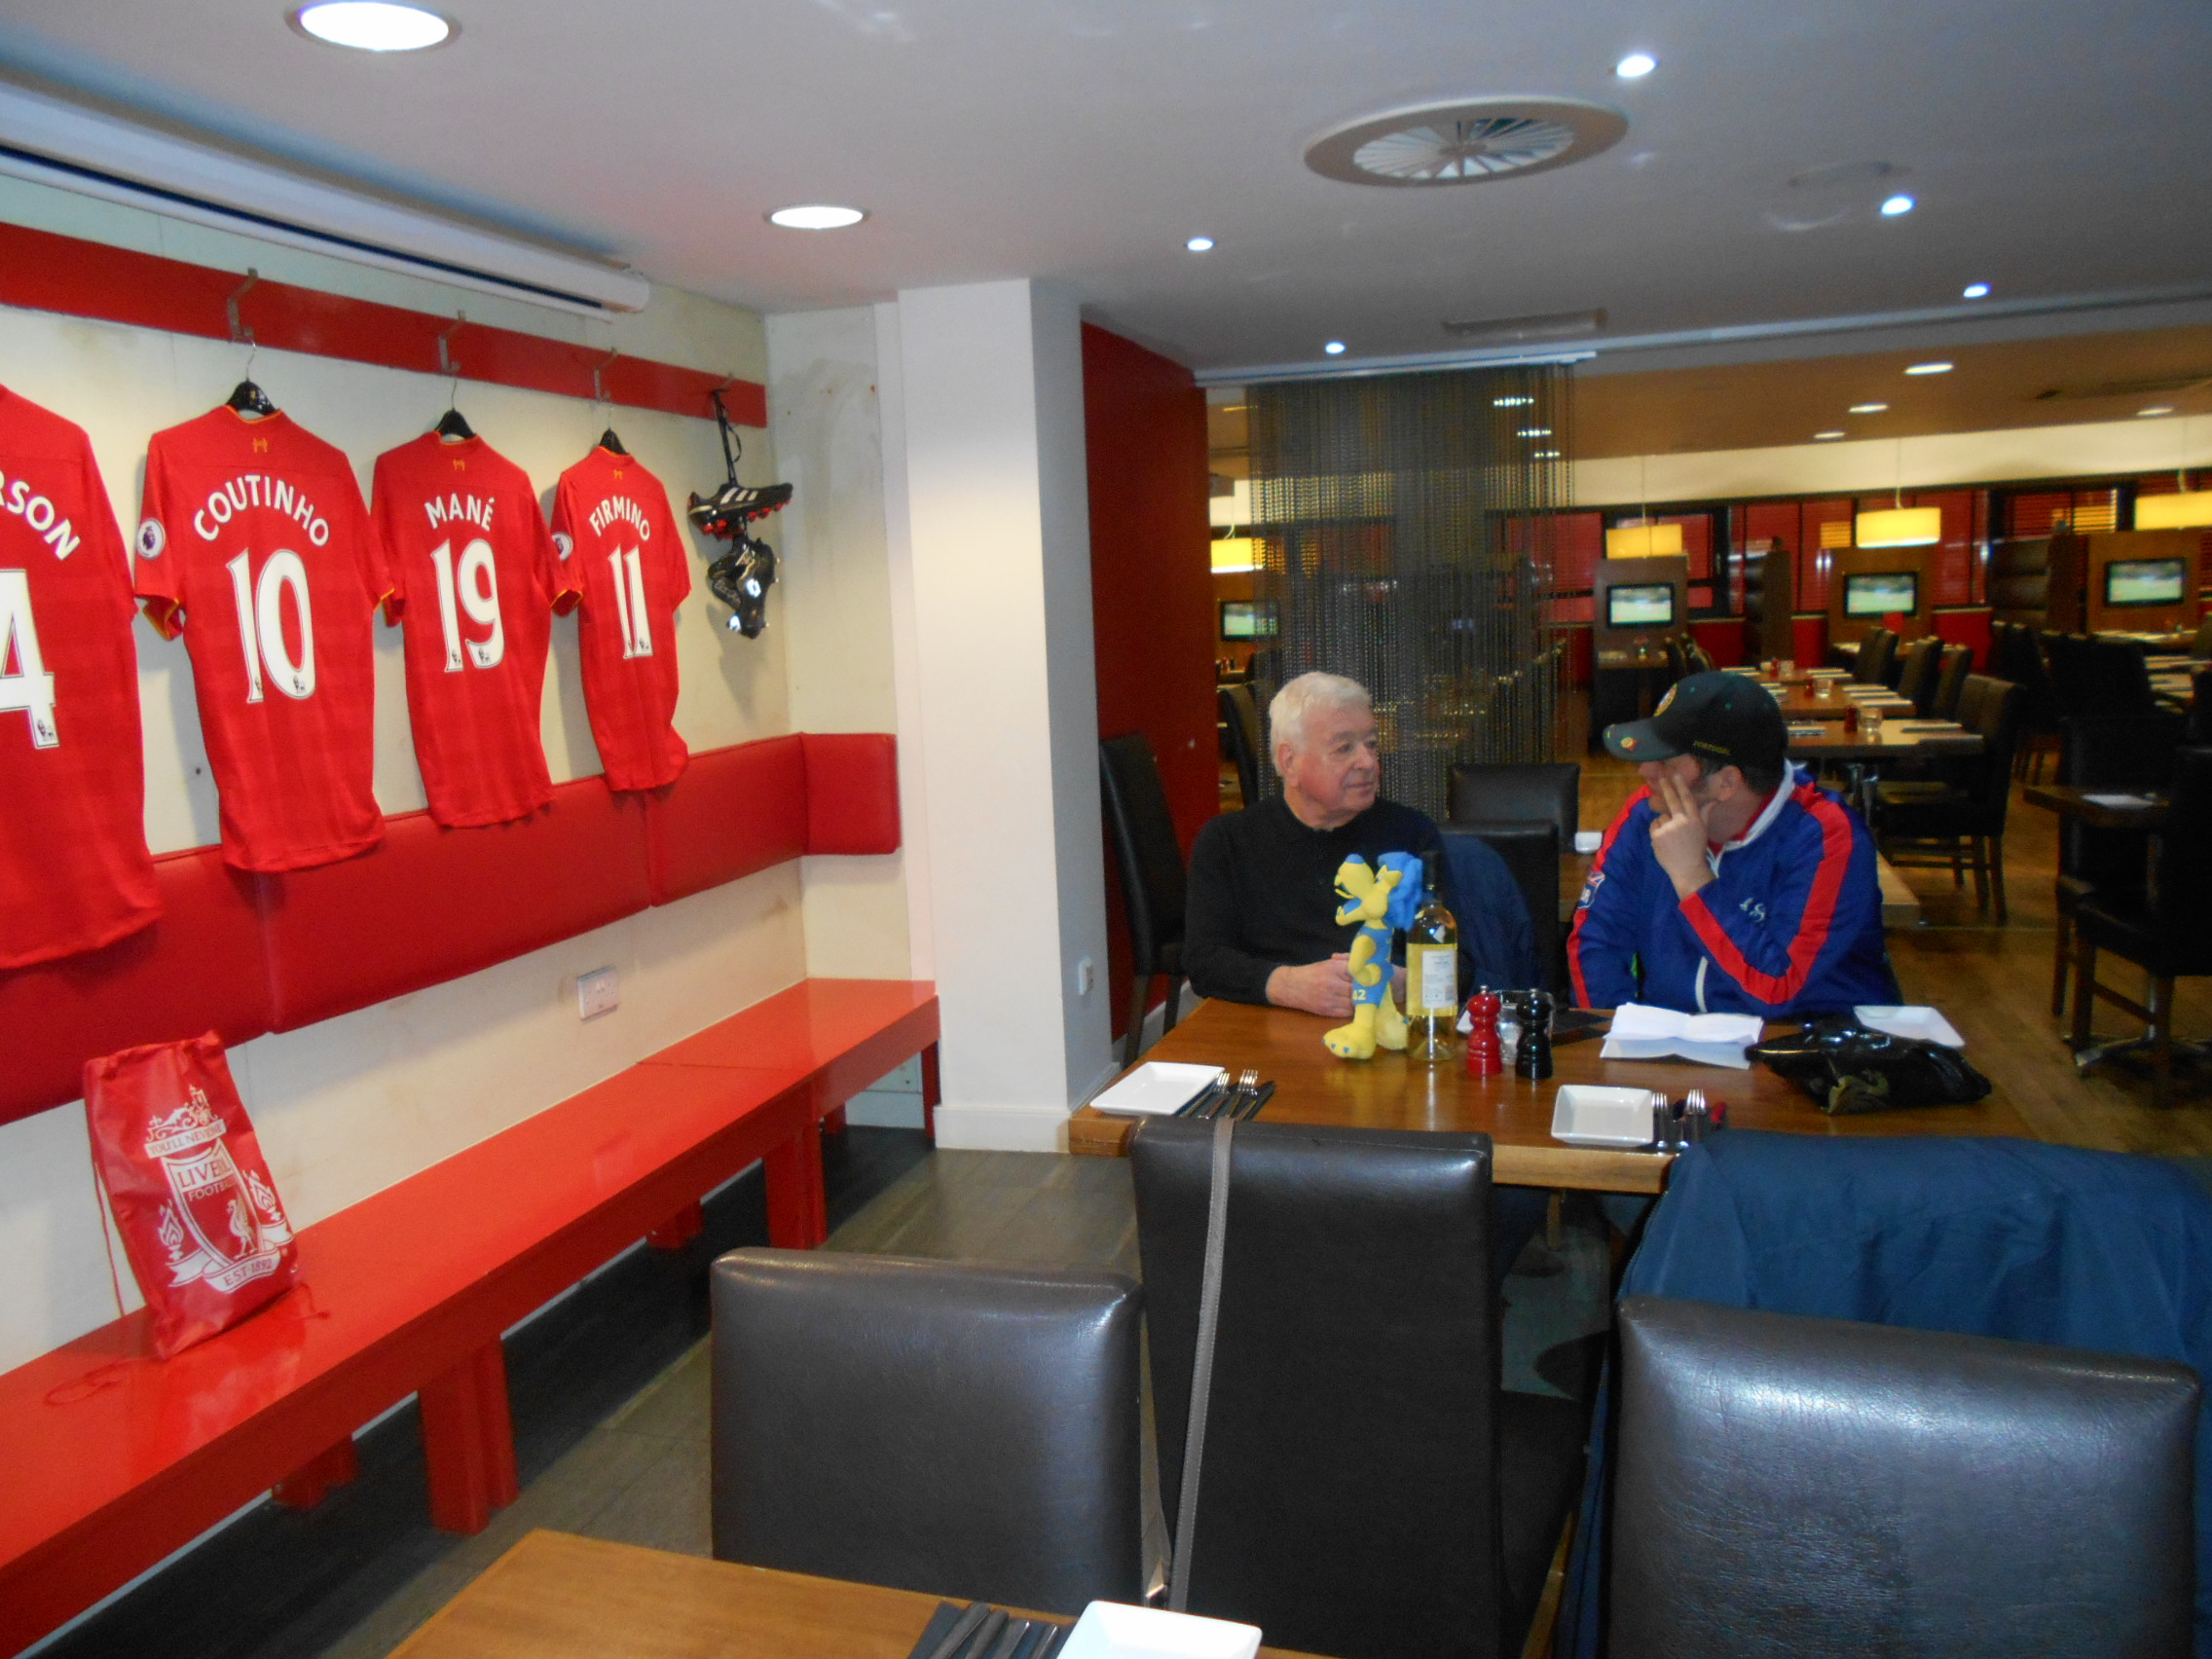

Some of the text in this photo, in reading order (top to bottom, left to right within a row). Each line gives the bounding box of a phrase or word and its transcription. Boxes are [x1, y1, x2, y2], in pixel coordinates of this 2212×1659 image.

[0, 468, 81, 561] SON
[194, 474, 329, 546] COUTINHO
[424, 493, 495, 532] MANÉ
[589, 495, 650, 541] FIRMINO
[226, 547, 316, 703] 10
[430, 537, 505, 673] 19
[608, 543, 653, 659] 11
[177, 1161, 227, 1188] LIVE
